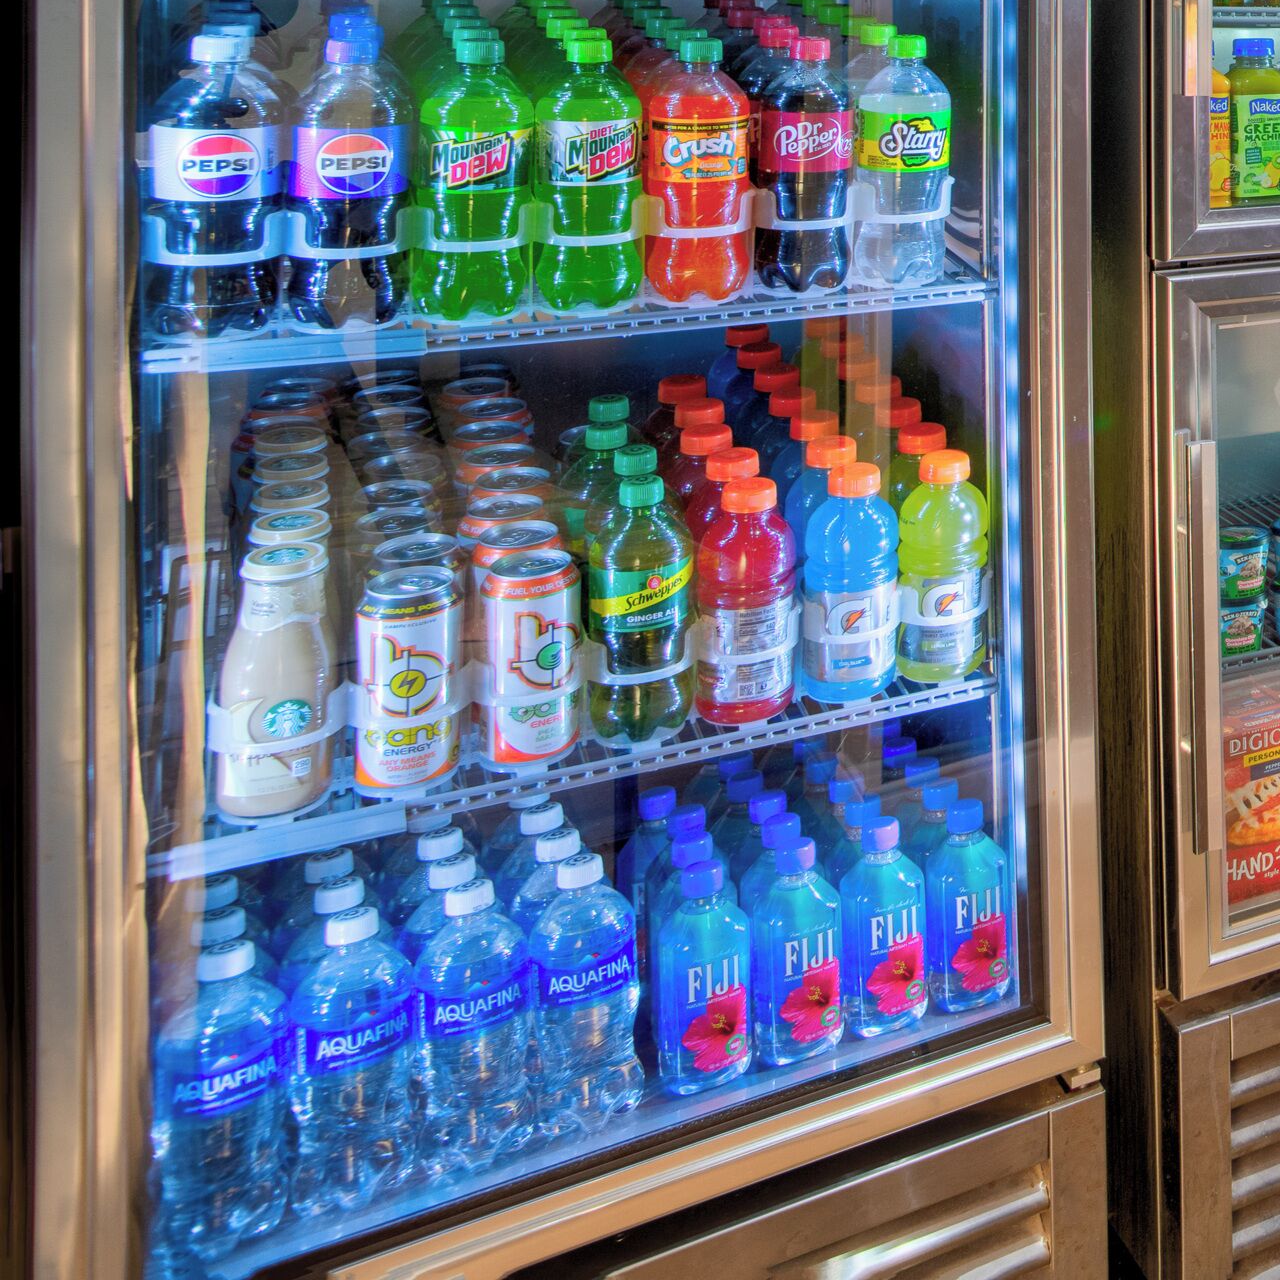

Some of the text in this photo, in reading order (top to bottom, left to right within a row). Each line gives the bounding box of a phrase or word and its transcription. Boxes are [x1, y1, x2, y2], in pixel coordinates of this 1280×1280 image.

[776, 129, 837, 157] Pepper
[798, 122, 822, 139] Dr
[881, 123, 948, 161] Starry
[182, 158, 255, 173] PEPSI
[320, 156, 388, 172] PEPSI
[663, 132, 736, 167] Crush
[625, 575, 683, 612] Schweppes
[627, 612, 664, 623] GINGER
[384, 741, 433, 757] ENERGY
[387, 761, 430, 773] ORANGE
[401, 751, 436, 766] MEANS
[955, 884, 1001, 931] FIJI
[870, 904, 919, 951] FIJI
[784, 927, 835, 977] FIJI
[548, 954, 631, 996] AQUAFINA
[687, 954, 740, 1005] FIJI
[433, 982, 522, 1027] AQUAFINA
[316, 1009, 410, 1063] AQUAFINA
